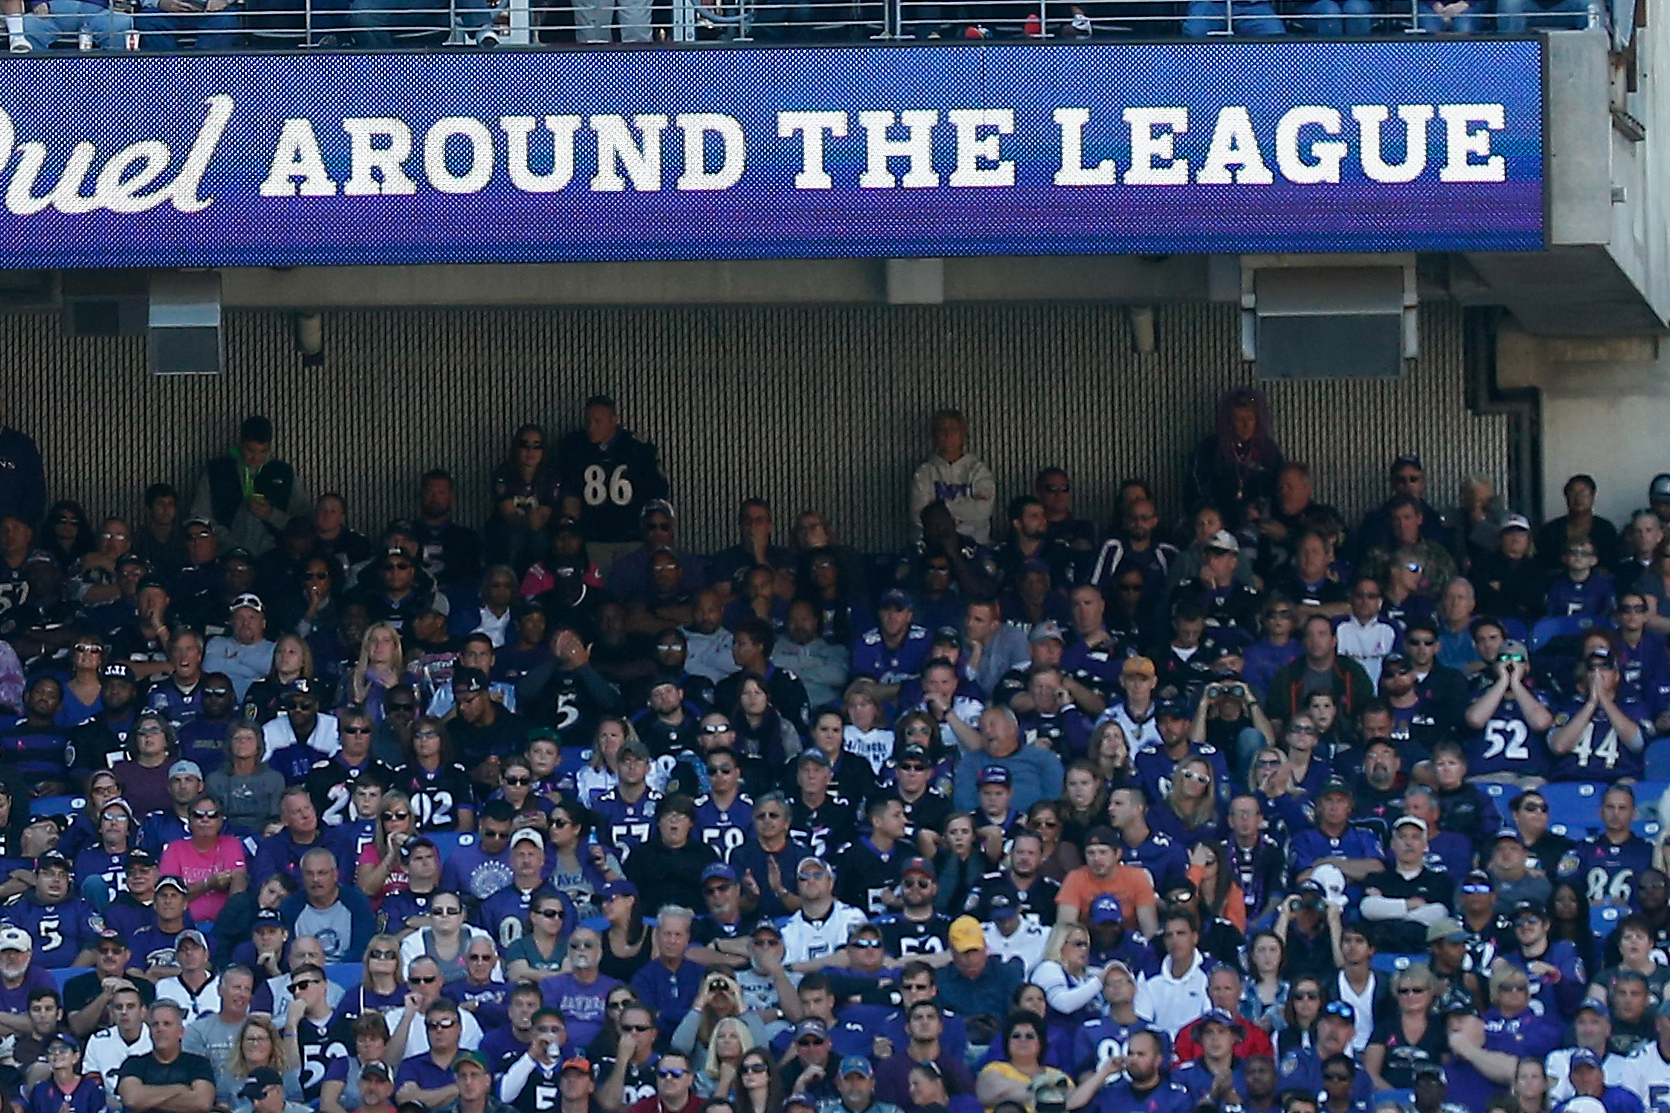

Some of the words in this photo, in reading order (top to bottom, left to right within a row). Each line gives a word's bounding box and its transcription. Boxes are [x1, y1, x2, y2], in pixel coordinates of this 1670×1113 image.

[258, 110, 747, 196] AROUND
[777, 109, 1016, 190] THE
[1053, 102, 1506, 186] LEAGUE
[584, 464, 633, 506] 86
[555, 691, 579, 730] 5
[1483, 721, 1529, 760] 52
[1574, 724, 1619, 768] 44
[611, 823, 650, 865] 57
[1587, 867, 1631, 905] 86
[40, 919, 61, 952] 5
